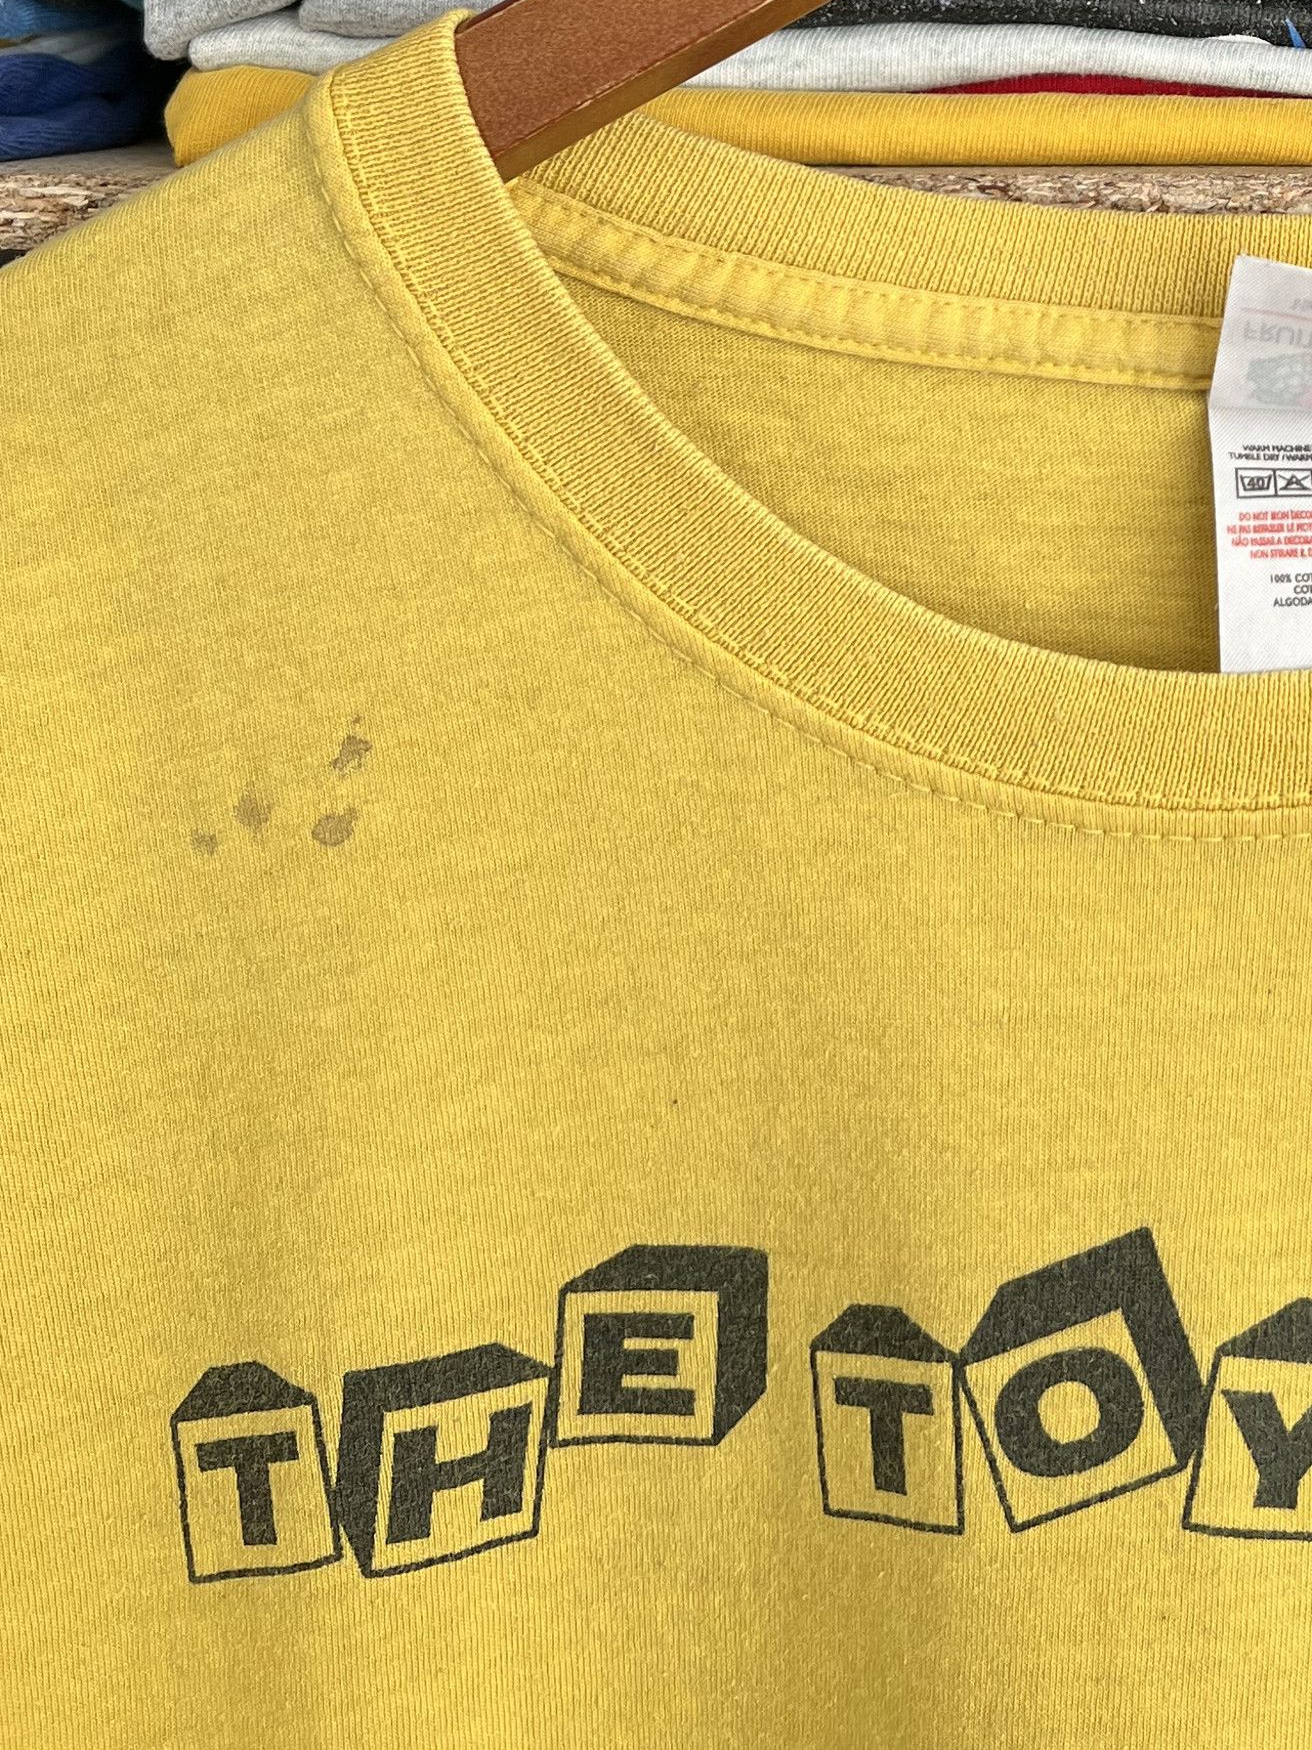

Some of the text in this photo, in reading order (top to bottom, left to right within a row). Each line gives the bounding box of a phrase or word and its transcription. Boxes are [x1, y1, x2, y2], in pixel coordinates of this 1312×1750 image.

[1228, 451, 1262, 461] TUMBLE
[1239, 512, 1251, 521] DO
[1252, 511, 1269, 520] NOT
[1270, 573, 1292, 584] 100%
[194, 1309, 698, 1549] THE
